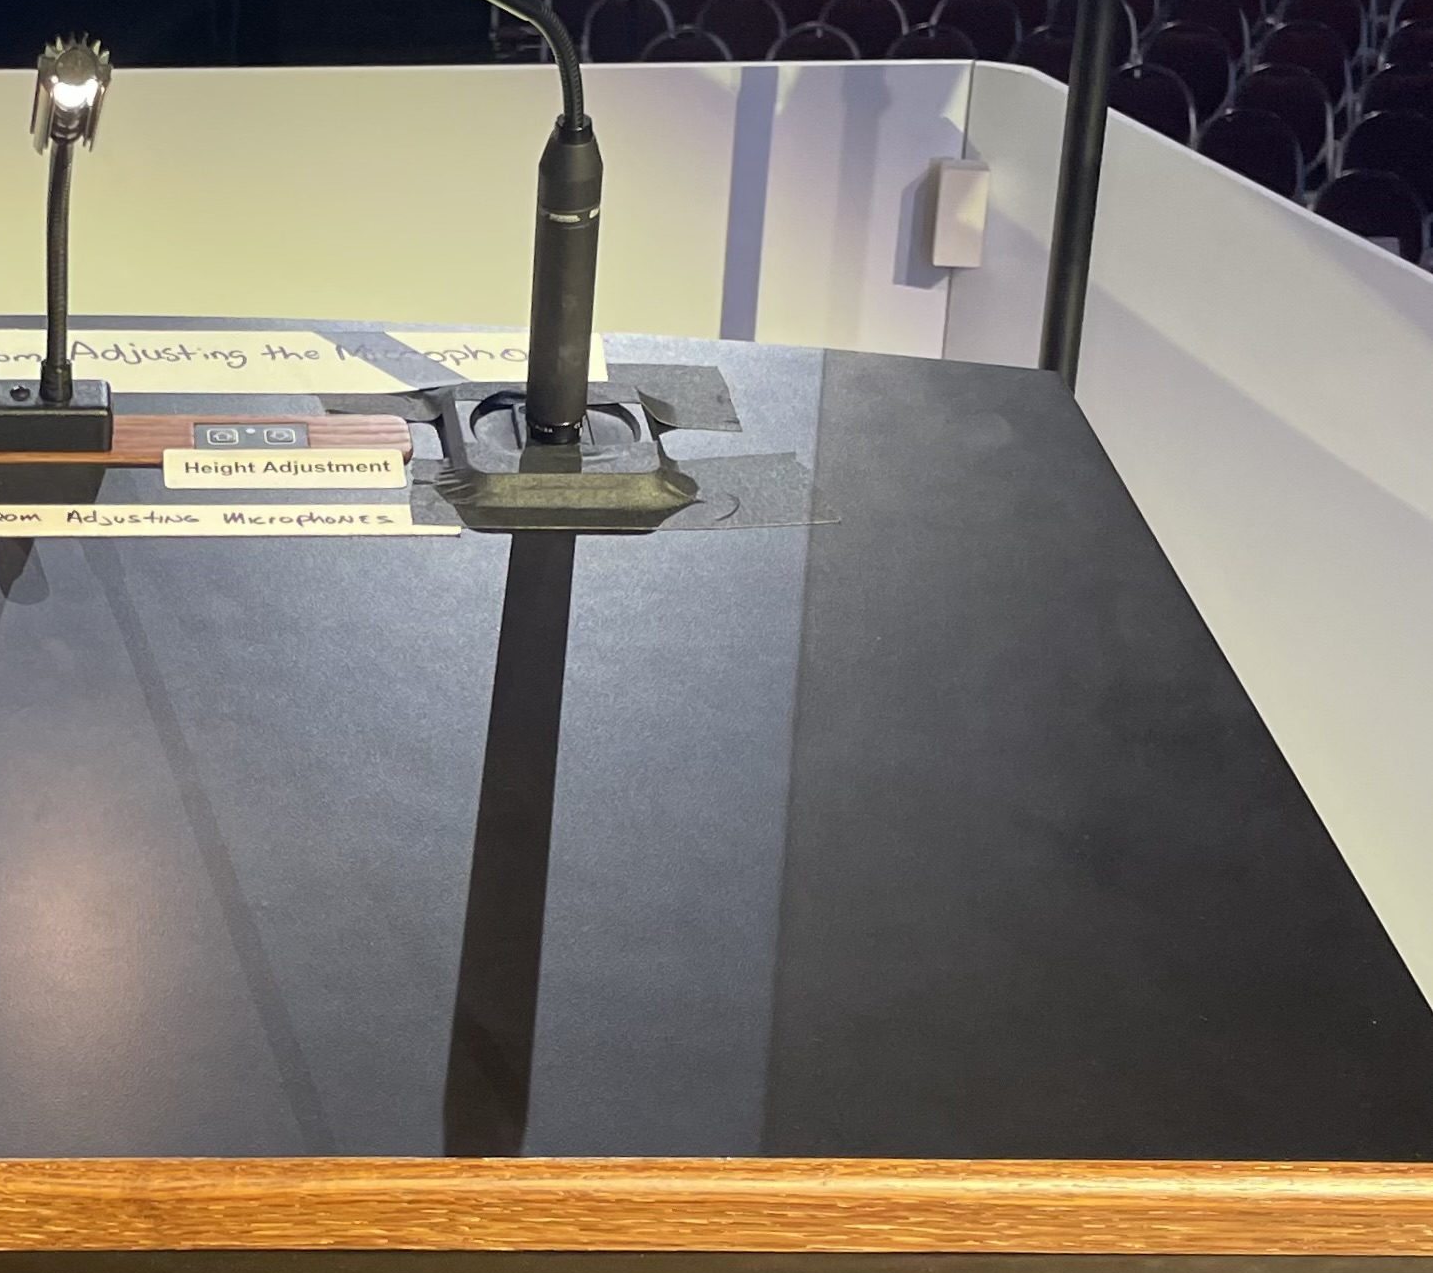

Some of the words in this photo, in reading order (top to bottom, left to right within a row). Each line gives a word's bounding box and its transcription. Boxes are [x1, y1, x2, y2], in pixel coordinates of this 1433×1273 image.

[70, 340, 247, 369] Adjusting
[261, 343, 320, 361] the
[184, 461, 256, 476] Height
[262, 460, 391, 476] Adjustment
